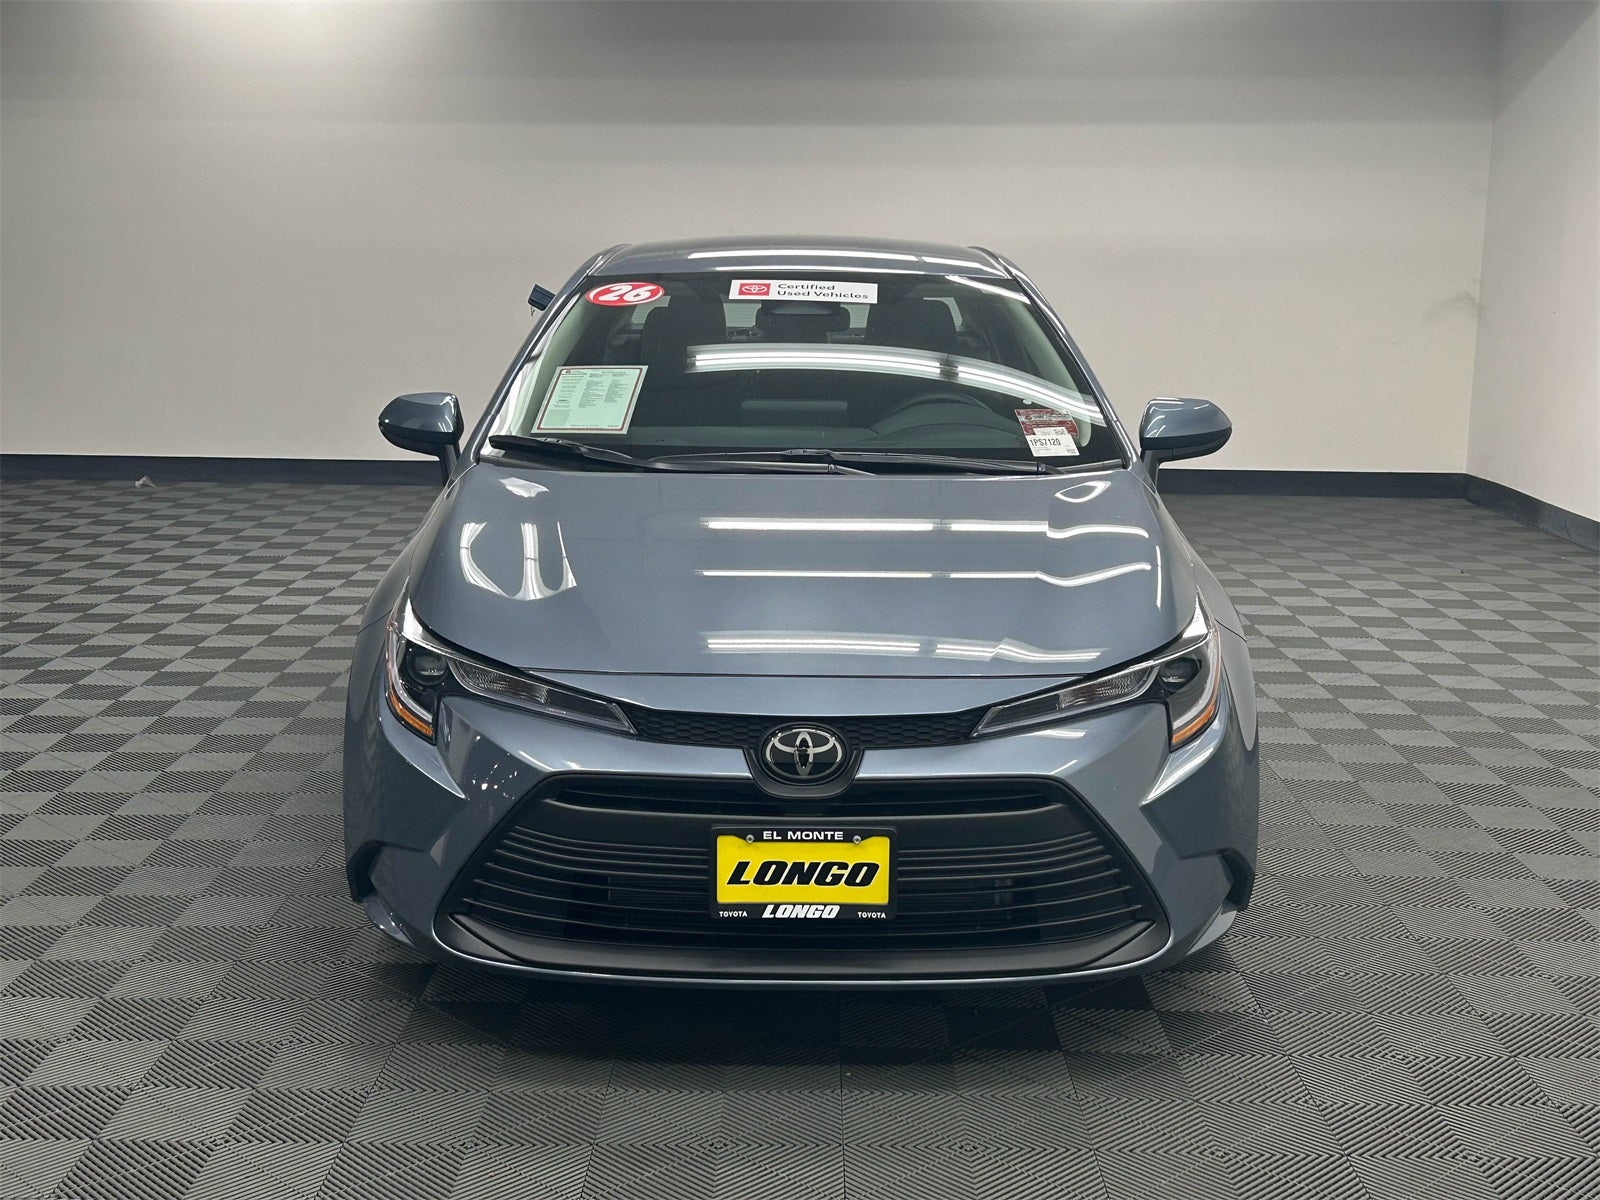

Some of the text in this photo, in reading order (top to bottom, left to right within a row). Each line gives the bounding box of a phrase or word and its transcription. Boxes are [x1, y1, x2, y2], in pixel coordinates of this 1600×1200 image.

[597, 284, 657, 302] 26
[778, 283, 835, 291] Certified
[814, 291, 869, 299] Vehicles
[763, 831, 844, 841] EL MONTE
[726, 860, 880, 887] LONGO
[761, 904, 840, 919] LONGO
[857, 911, 886, 919] TOYOTA
